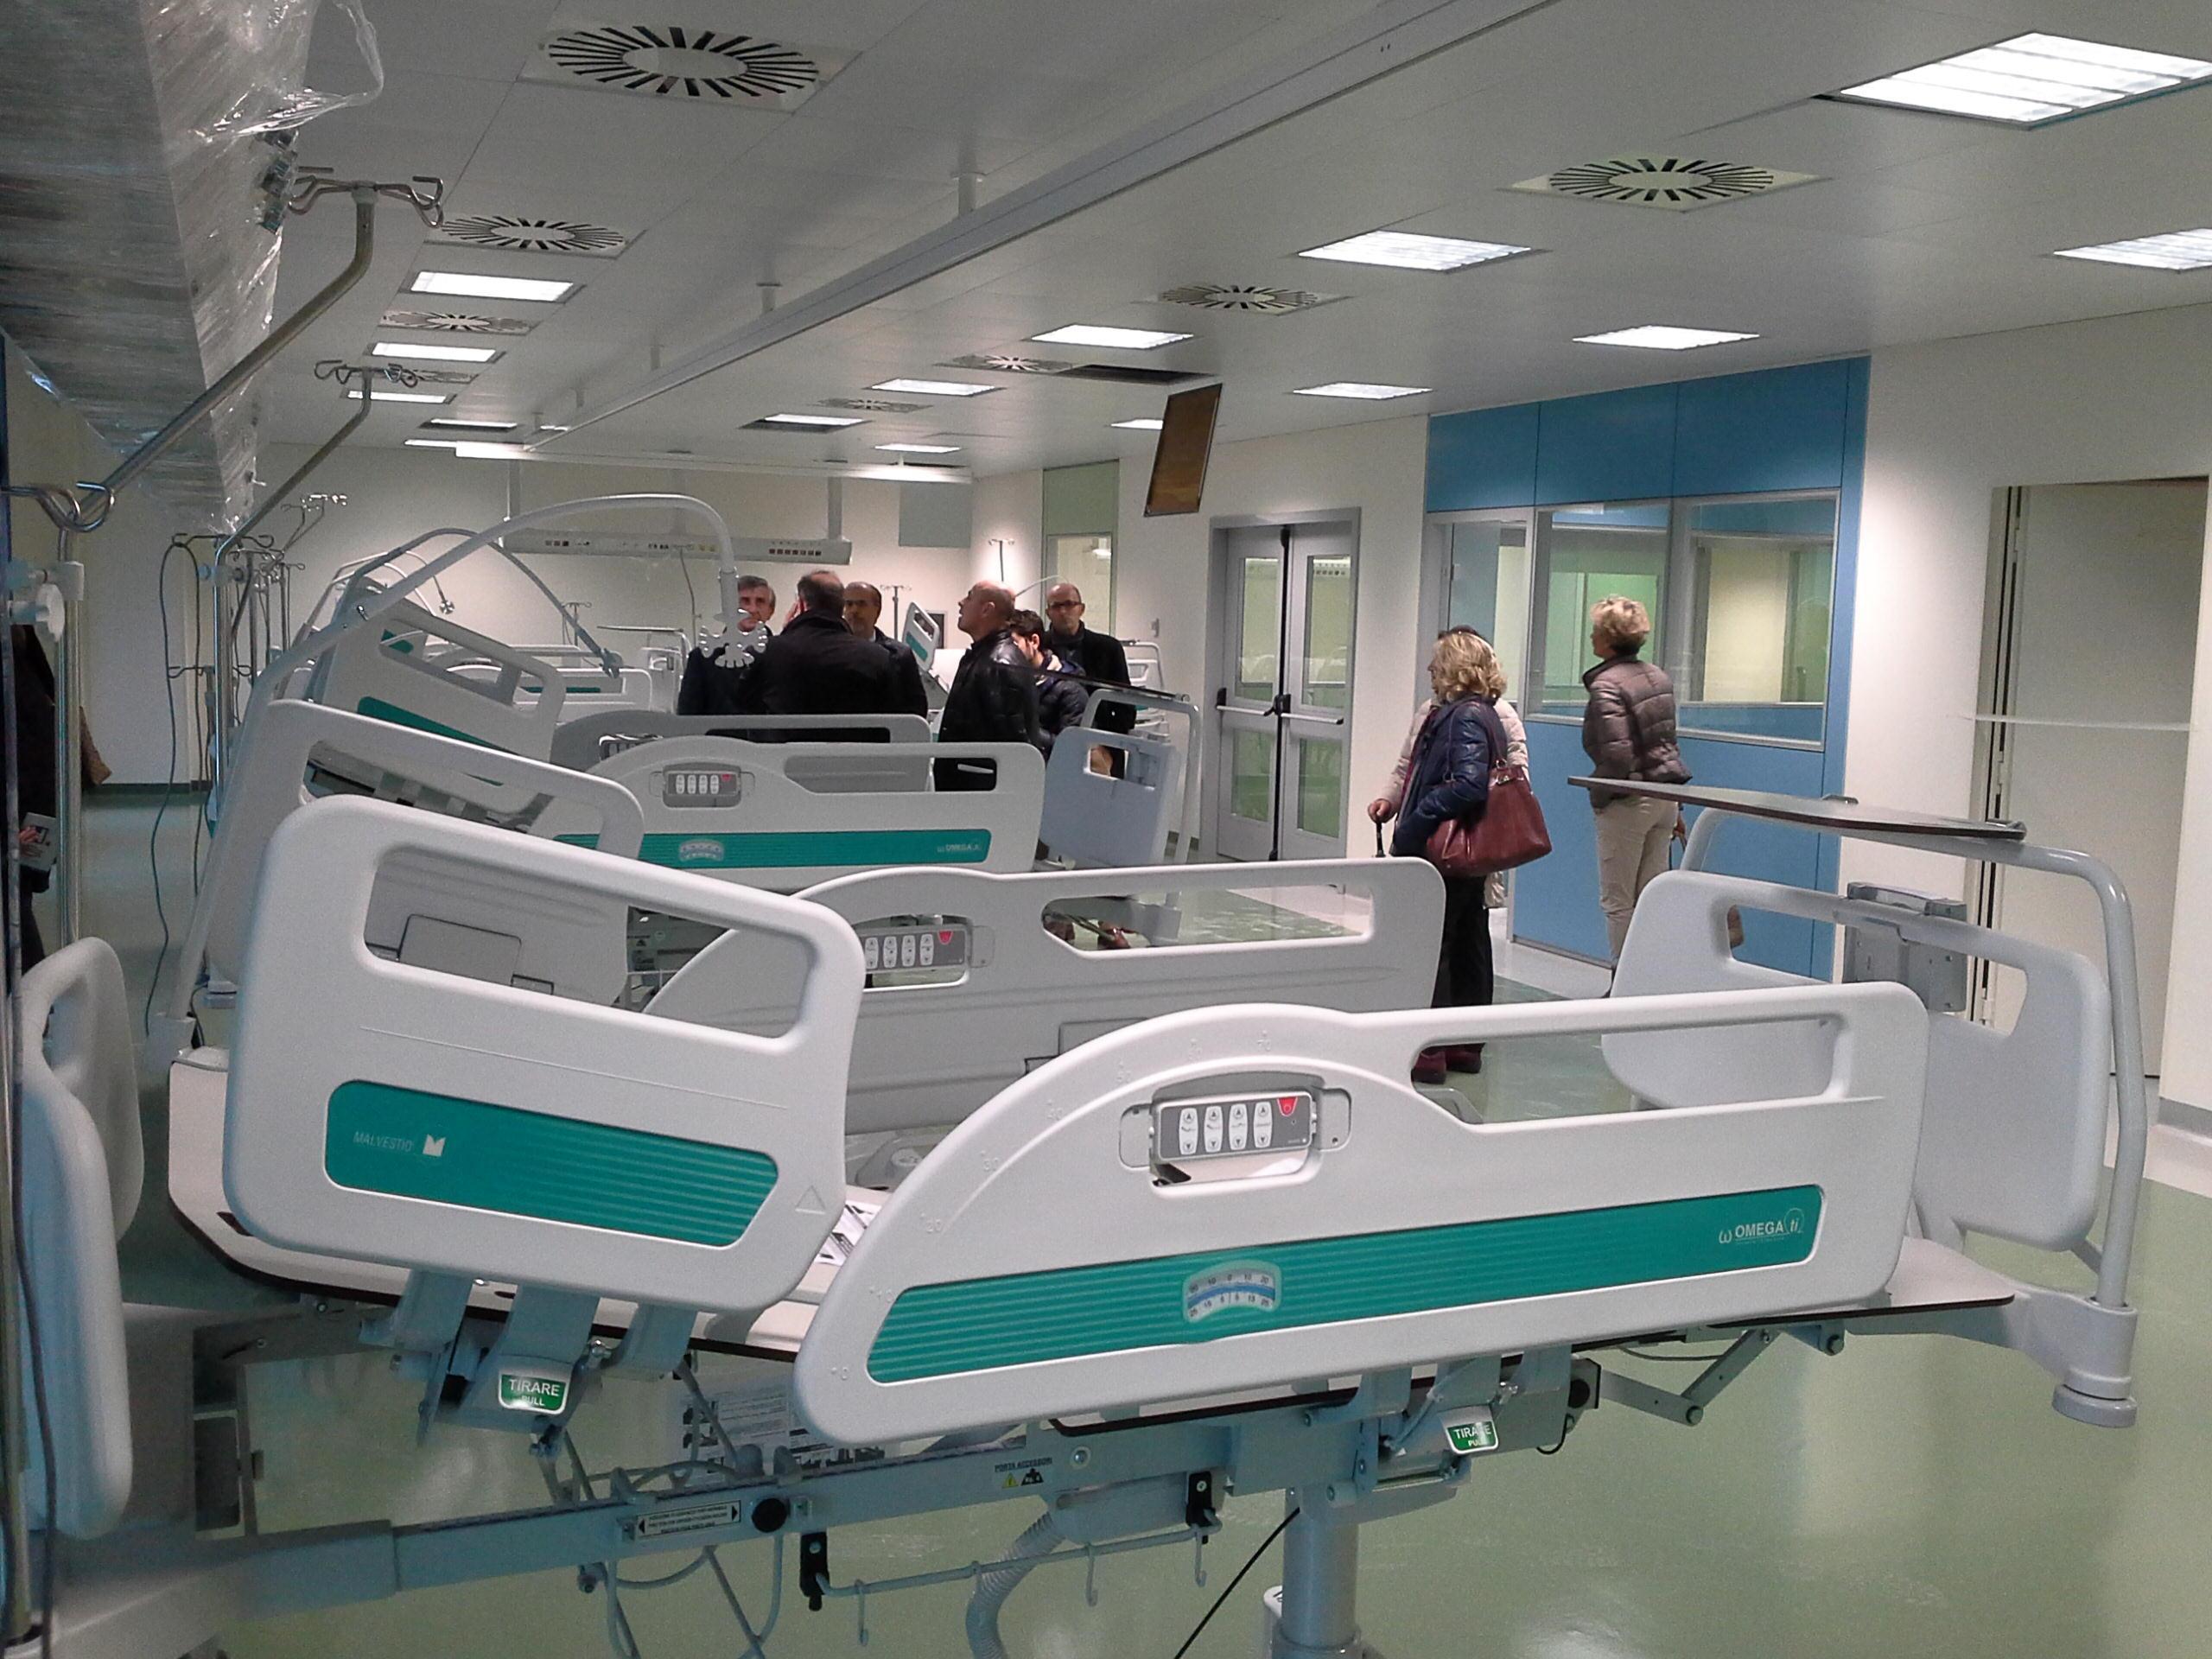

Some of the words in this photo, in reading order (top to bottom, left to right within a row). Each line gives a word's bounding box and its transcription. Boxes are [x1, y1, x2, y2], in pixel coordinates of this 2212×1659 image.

[1735, 1221, 1784, 1238] OMEGA
[509, 1379, 561, 1396] TIRARE
[521, 1395, 545, 1407] PULL
[1453, 1424, 1492, 1440] TIRAE
